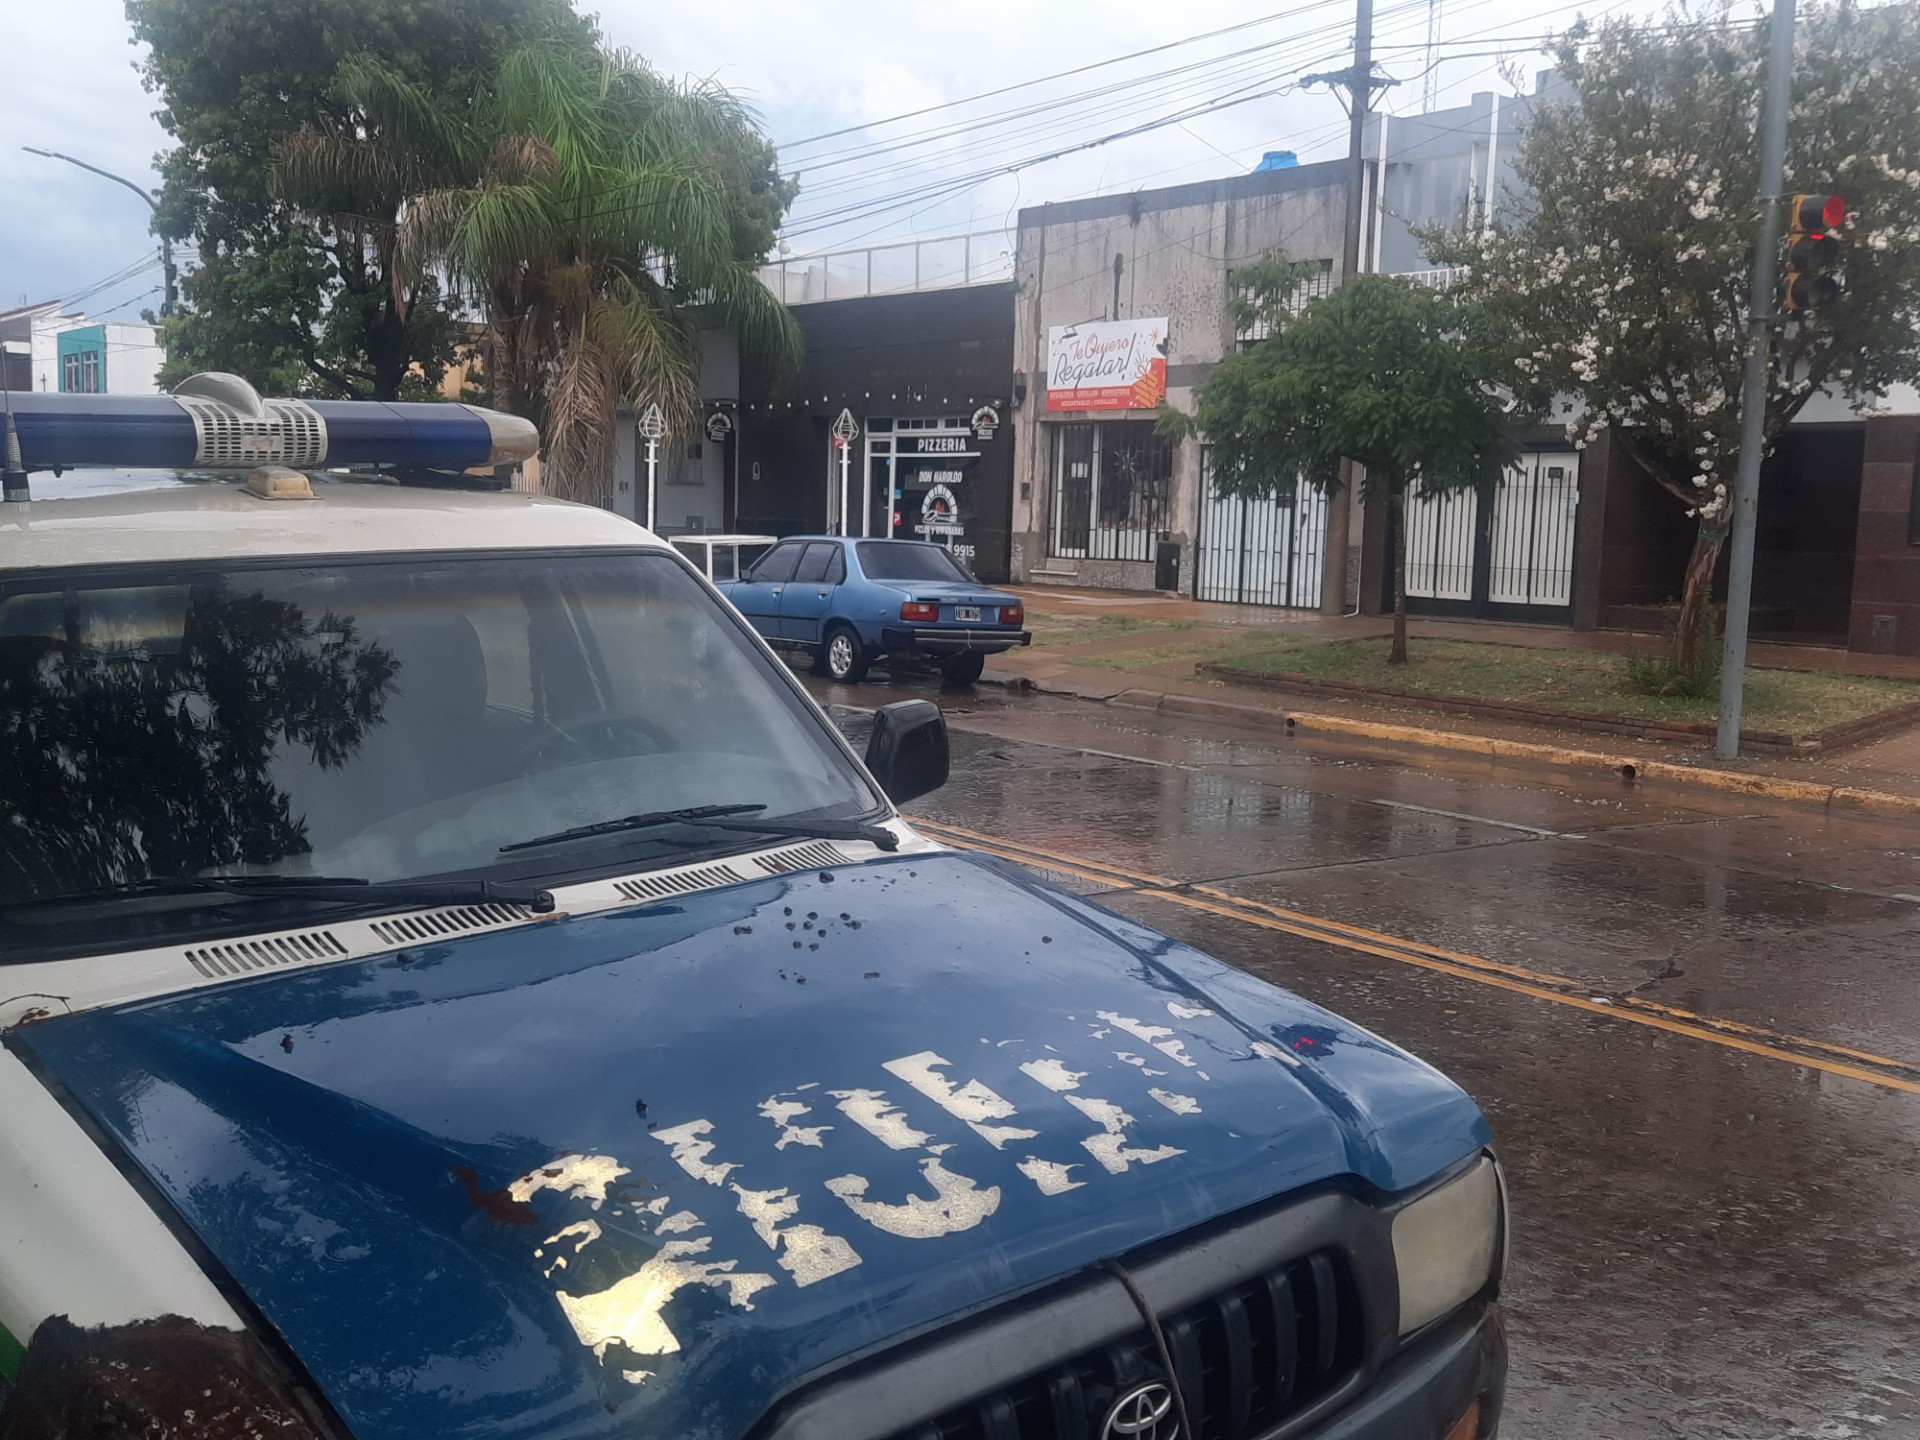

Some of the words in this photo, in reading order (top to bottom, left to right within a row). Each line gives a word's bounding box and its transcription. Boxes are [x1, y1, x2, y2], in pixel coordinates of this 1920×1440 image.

[1069, 340, 1084, 362] Te
[1085, 332, 1130, 359] Quiero
[917, 438, 967, 452] PIZZERIA
[918, 471, 932, 482] DON
[933, 471, 963, 483] HAROLDO
[953, 544, 975, 557] 9915
